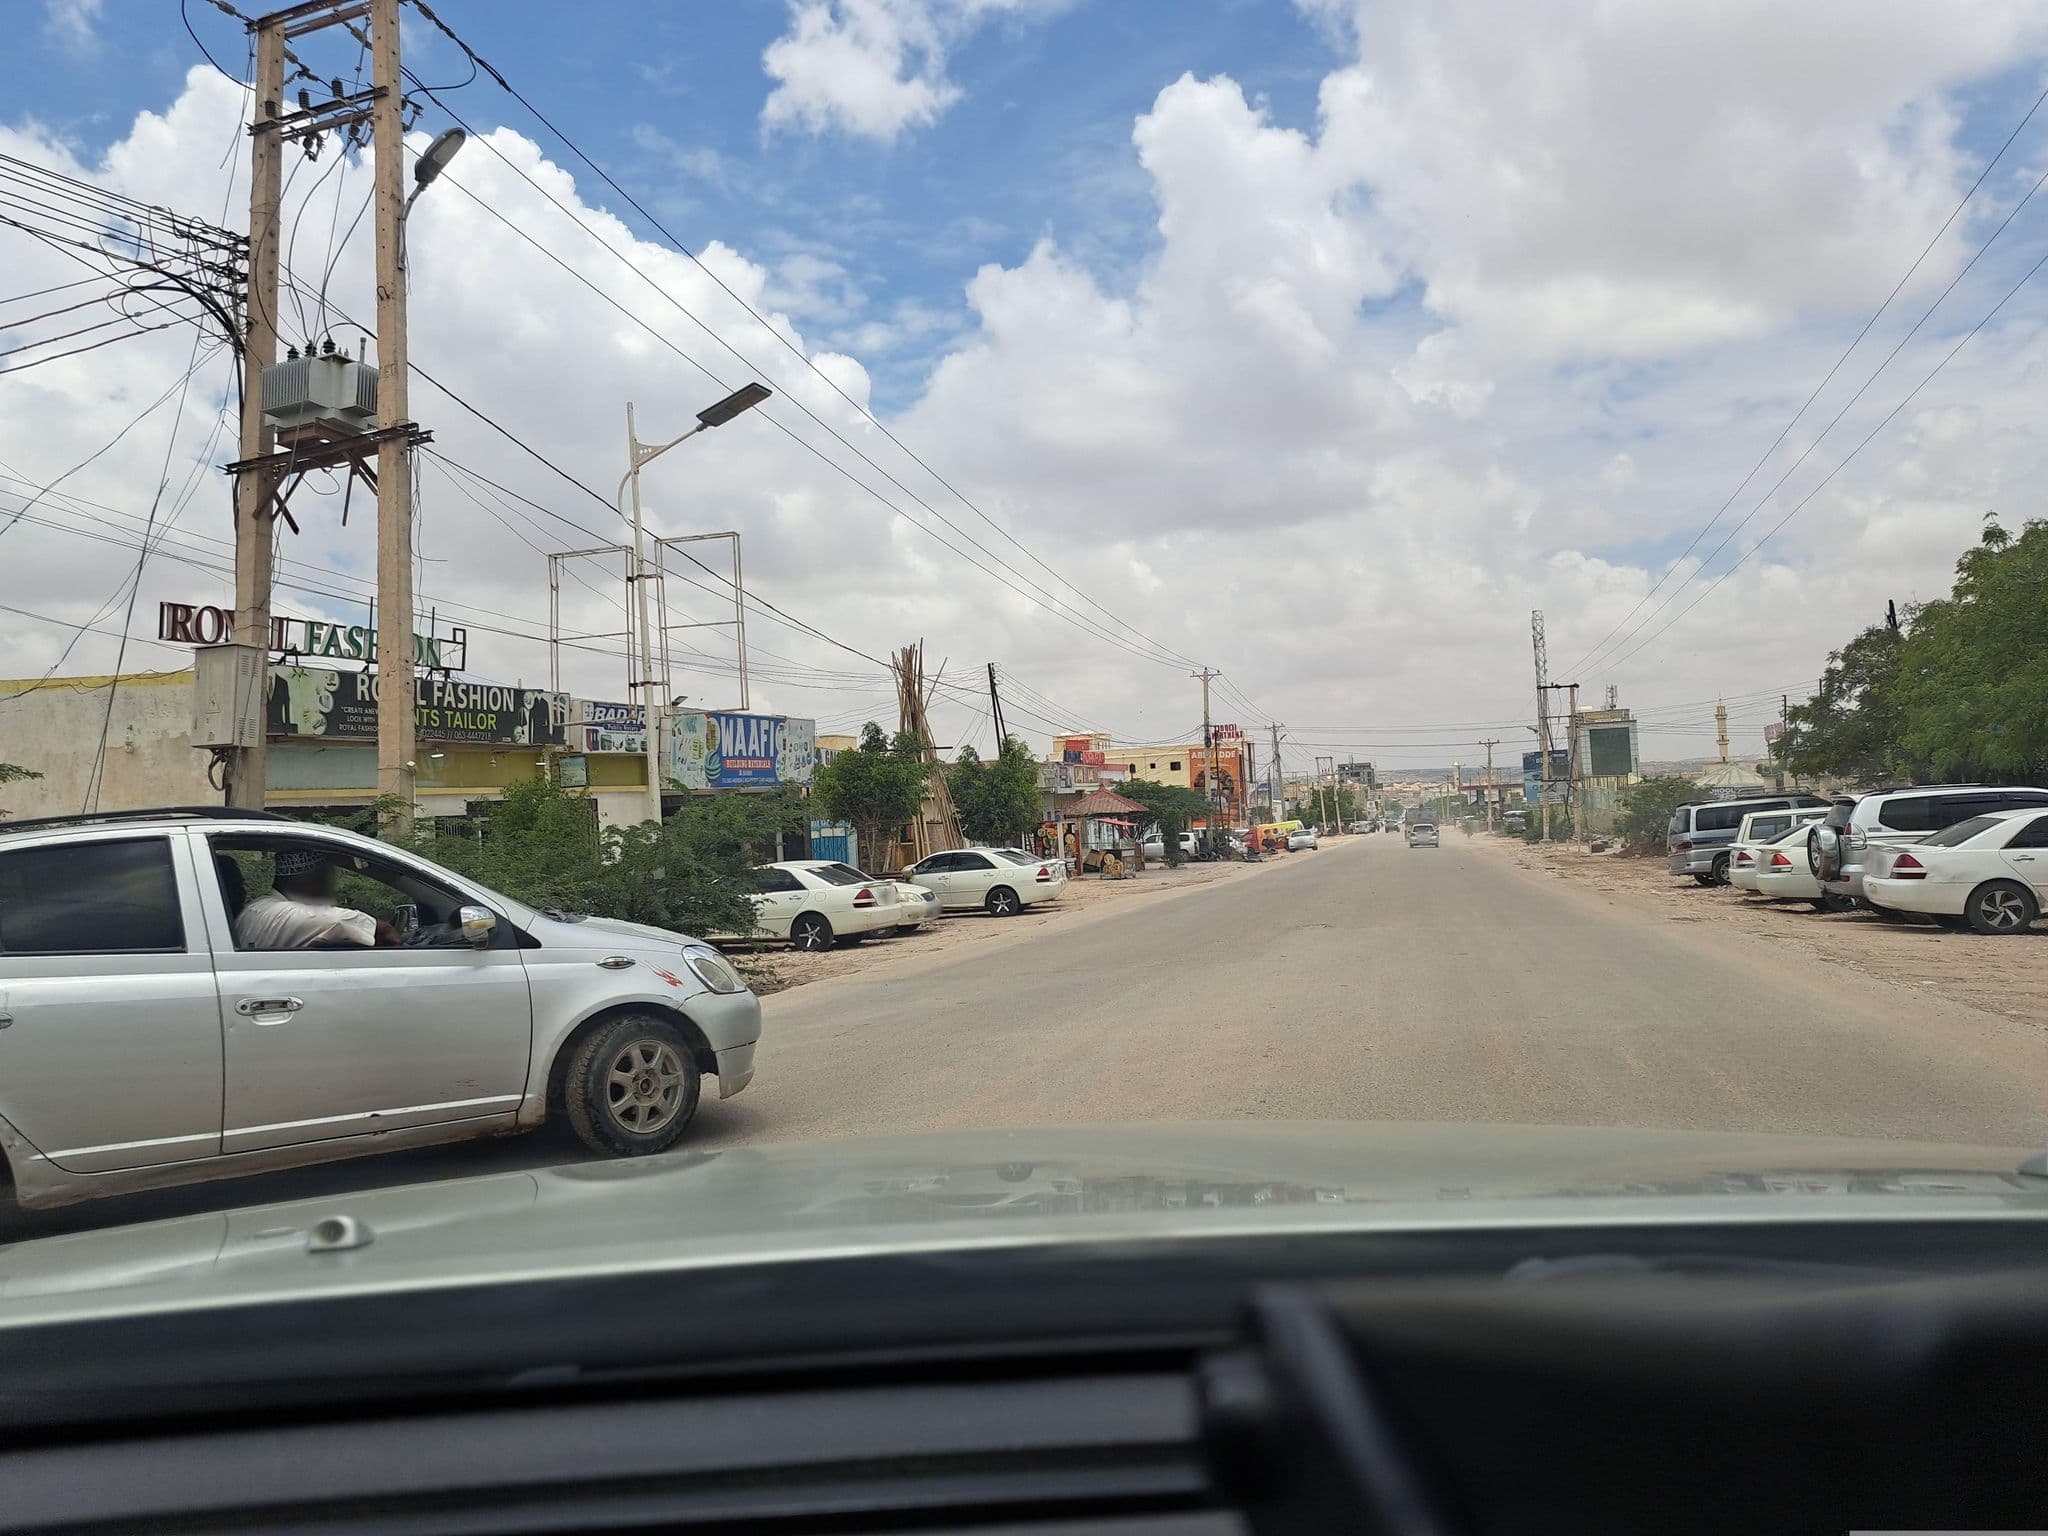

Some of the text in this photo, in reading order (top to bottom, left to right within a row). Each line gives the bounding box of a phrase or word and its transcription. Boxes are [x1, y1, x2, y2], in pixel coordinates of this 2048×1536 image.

[166, 602, 301, 652] ROL
[357, 674, 514, 712] ROL FASHION
[445, 710, 496, 730] TAILOR
[593, 707, 646, 725] BADAR
[720, 716, 774, 757] WAAFI
